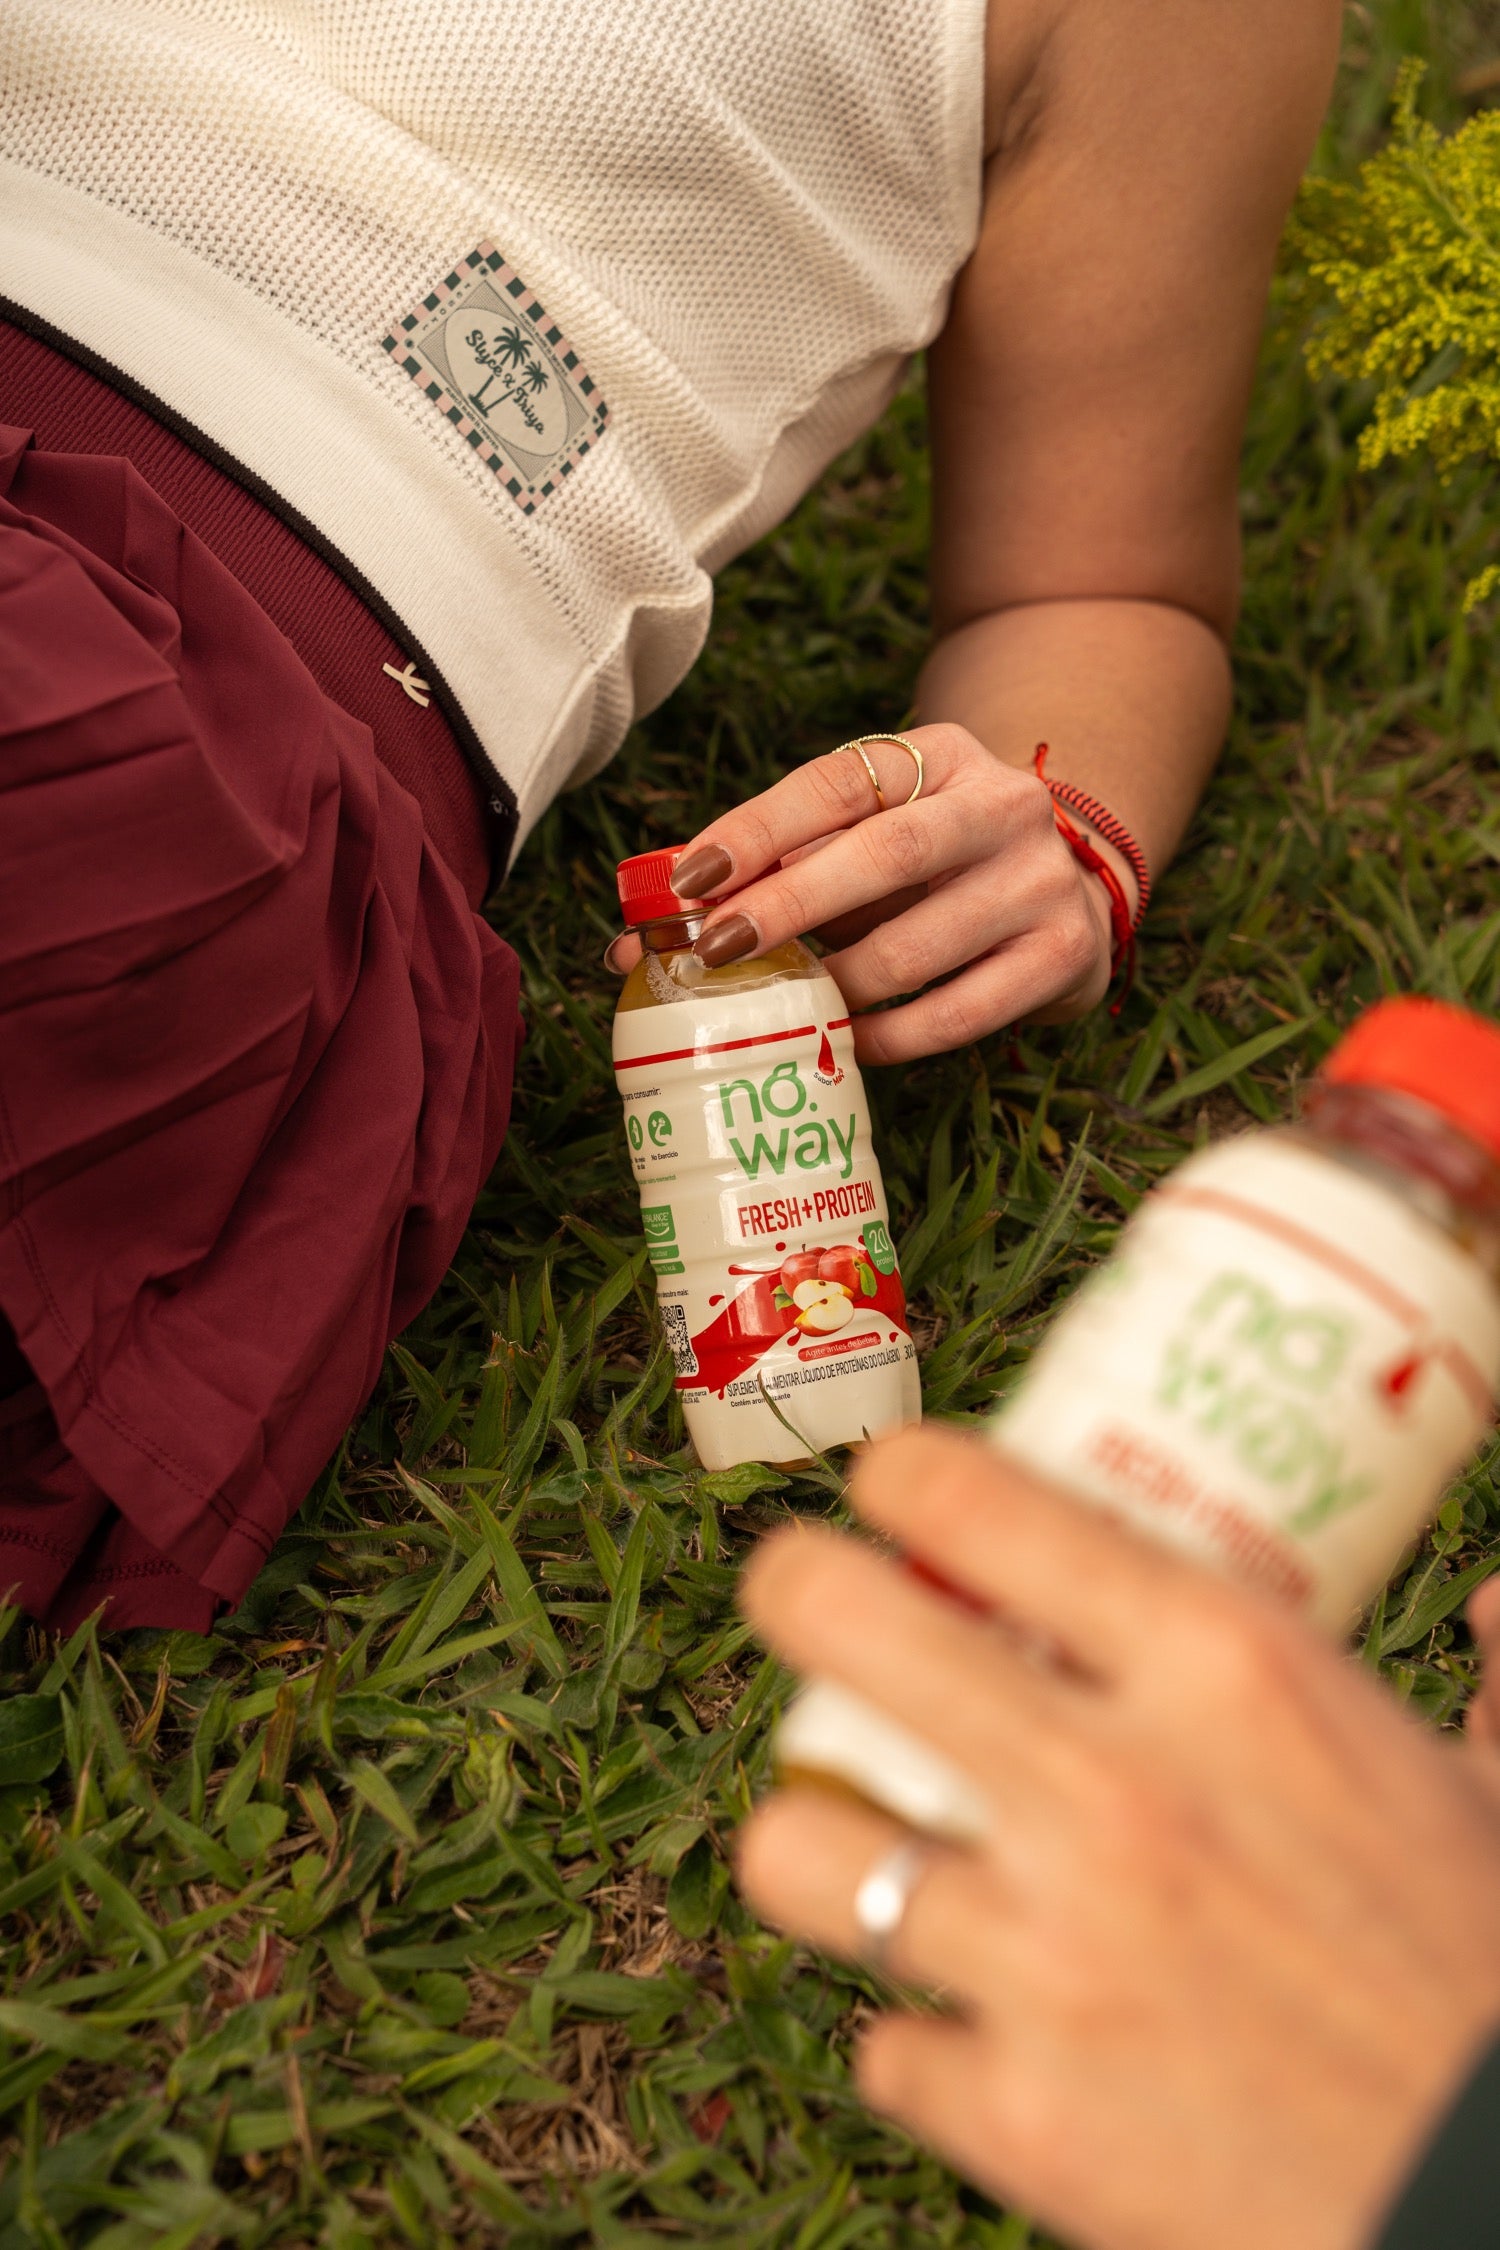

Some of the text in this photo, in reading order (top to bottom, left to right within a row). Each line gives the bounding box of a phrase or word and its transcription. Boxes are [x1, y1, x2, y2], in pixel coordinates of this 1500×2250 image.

[465, 329, 503, 377] Slyce
[513, 387, 545, 435] Triya
[813, 1072, 832, 1086] Sabor
[728, 1113, 856, 1181] way
[805, 1349, 826, 1359] Agite
[726, 1380, 762, 1398] SUPLEMENT
[800, 1366, 827, 1385] LÍQUIDO
[826, 1362, 836, 1379] DE
[835, 1356, 870, 1376] PROTEÍNAS
[730, 1393, 791, 1408] Contém aromizante
